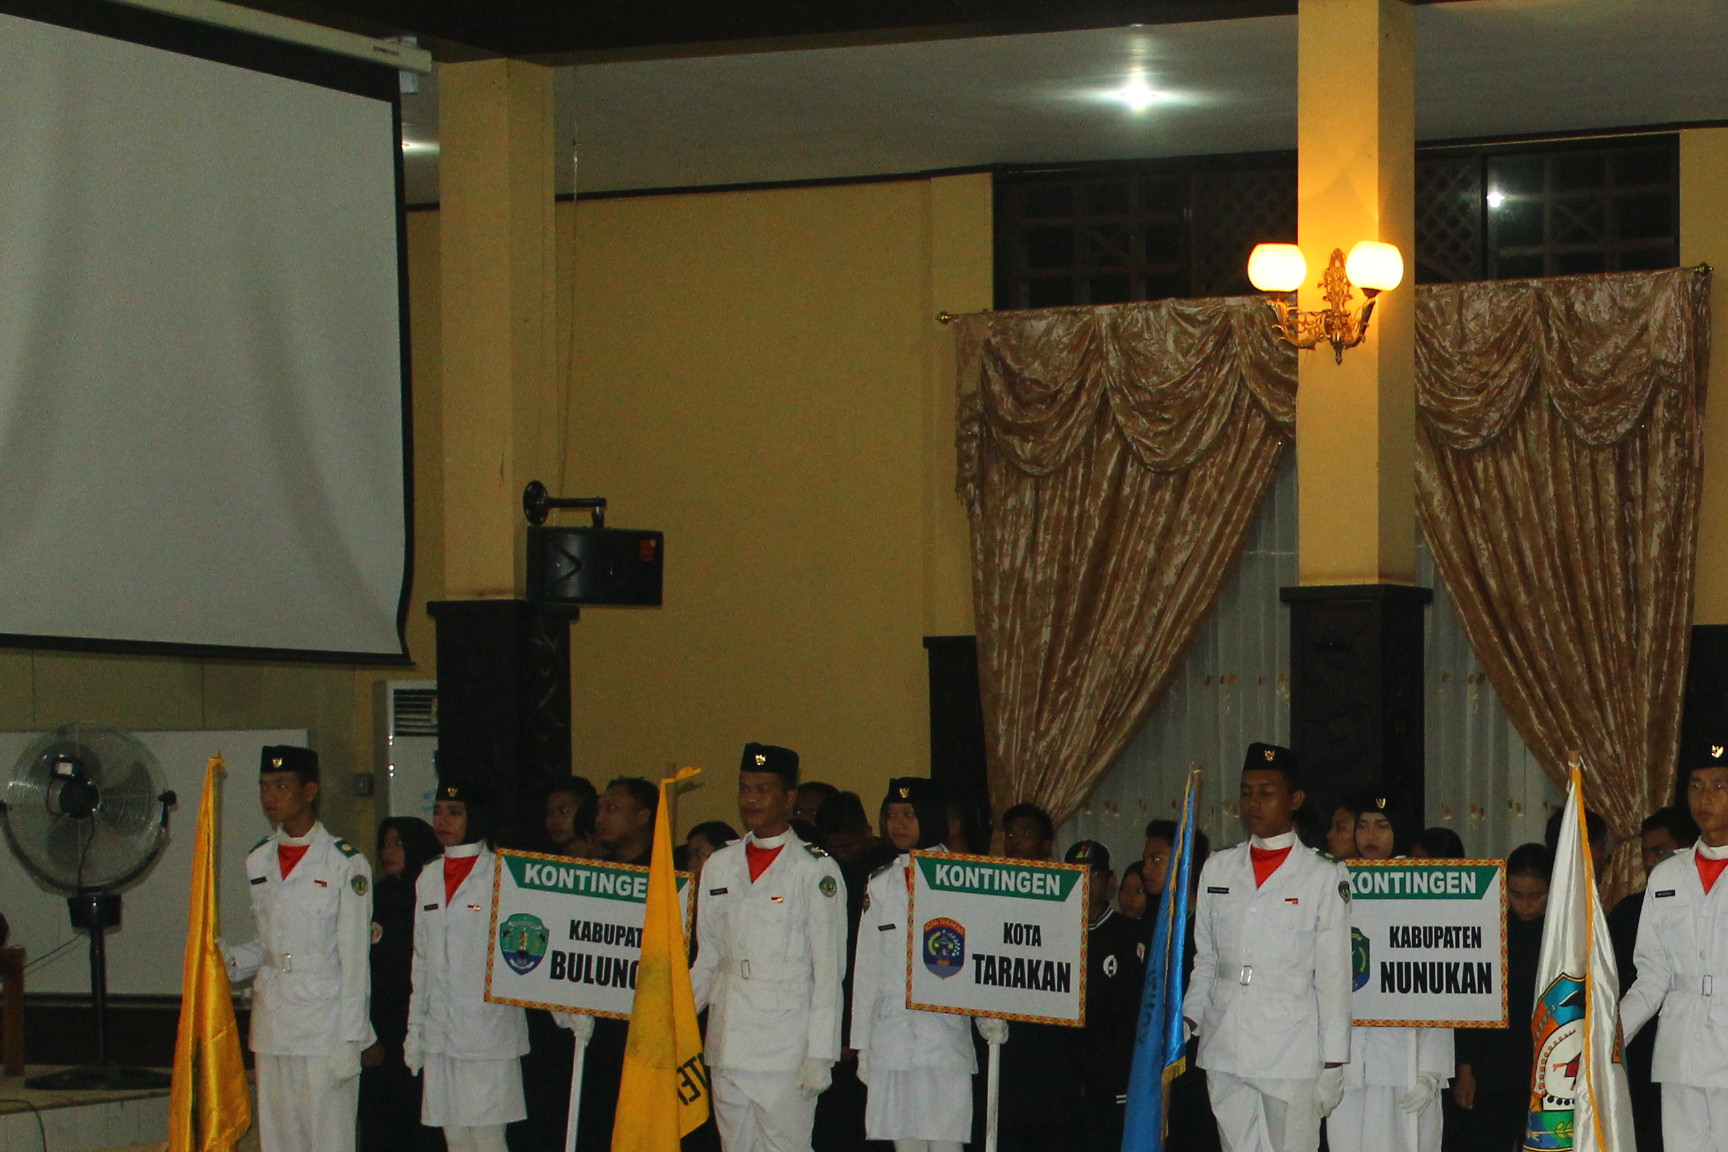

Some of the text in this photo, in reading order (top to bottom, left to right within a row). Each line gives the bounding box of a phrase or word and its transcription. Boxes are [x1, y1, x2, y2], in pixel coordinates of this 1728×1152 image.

[524, 863, 648, 899] KONTINGE
[935, 863, 1060, 896] KONTINGEN
[1003, 922, 1042, 948] KOTA
[1389, 926, 1482, 949] KABUPATEN
[972, 954, 1071, 994] TARAKAN
[1380, 961, 1492, 994] NUNUKAN
